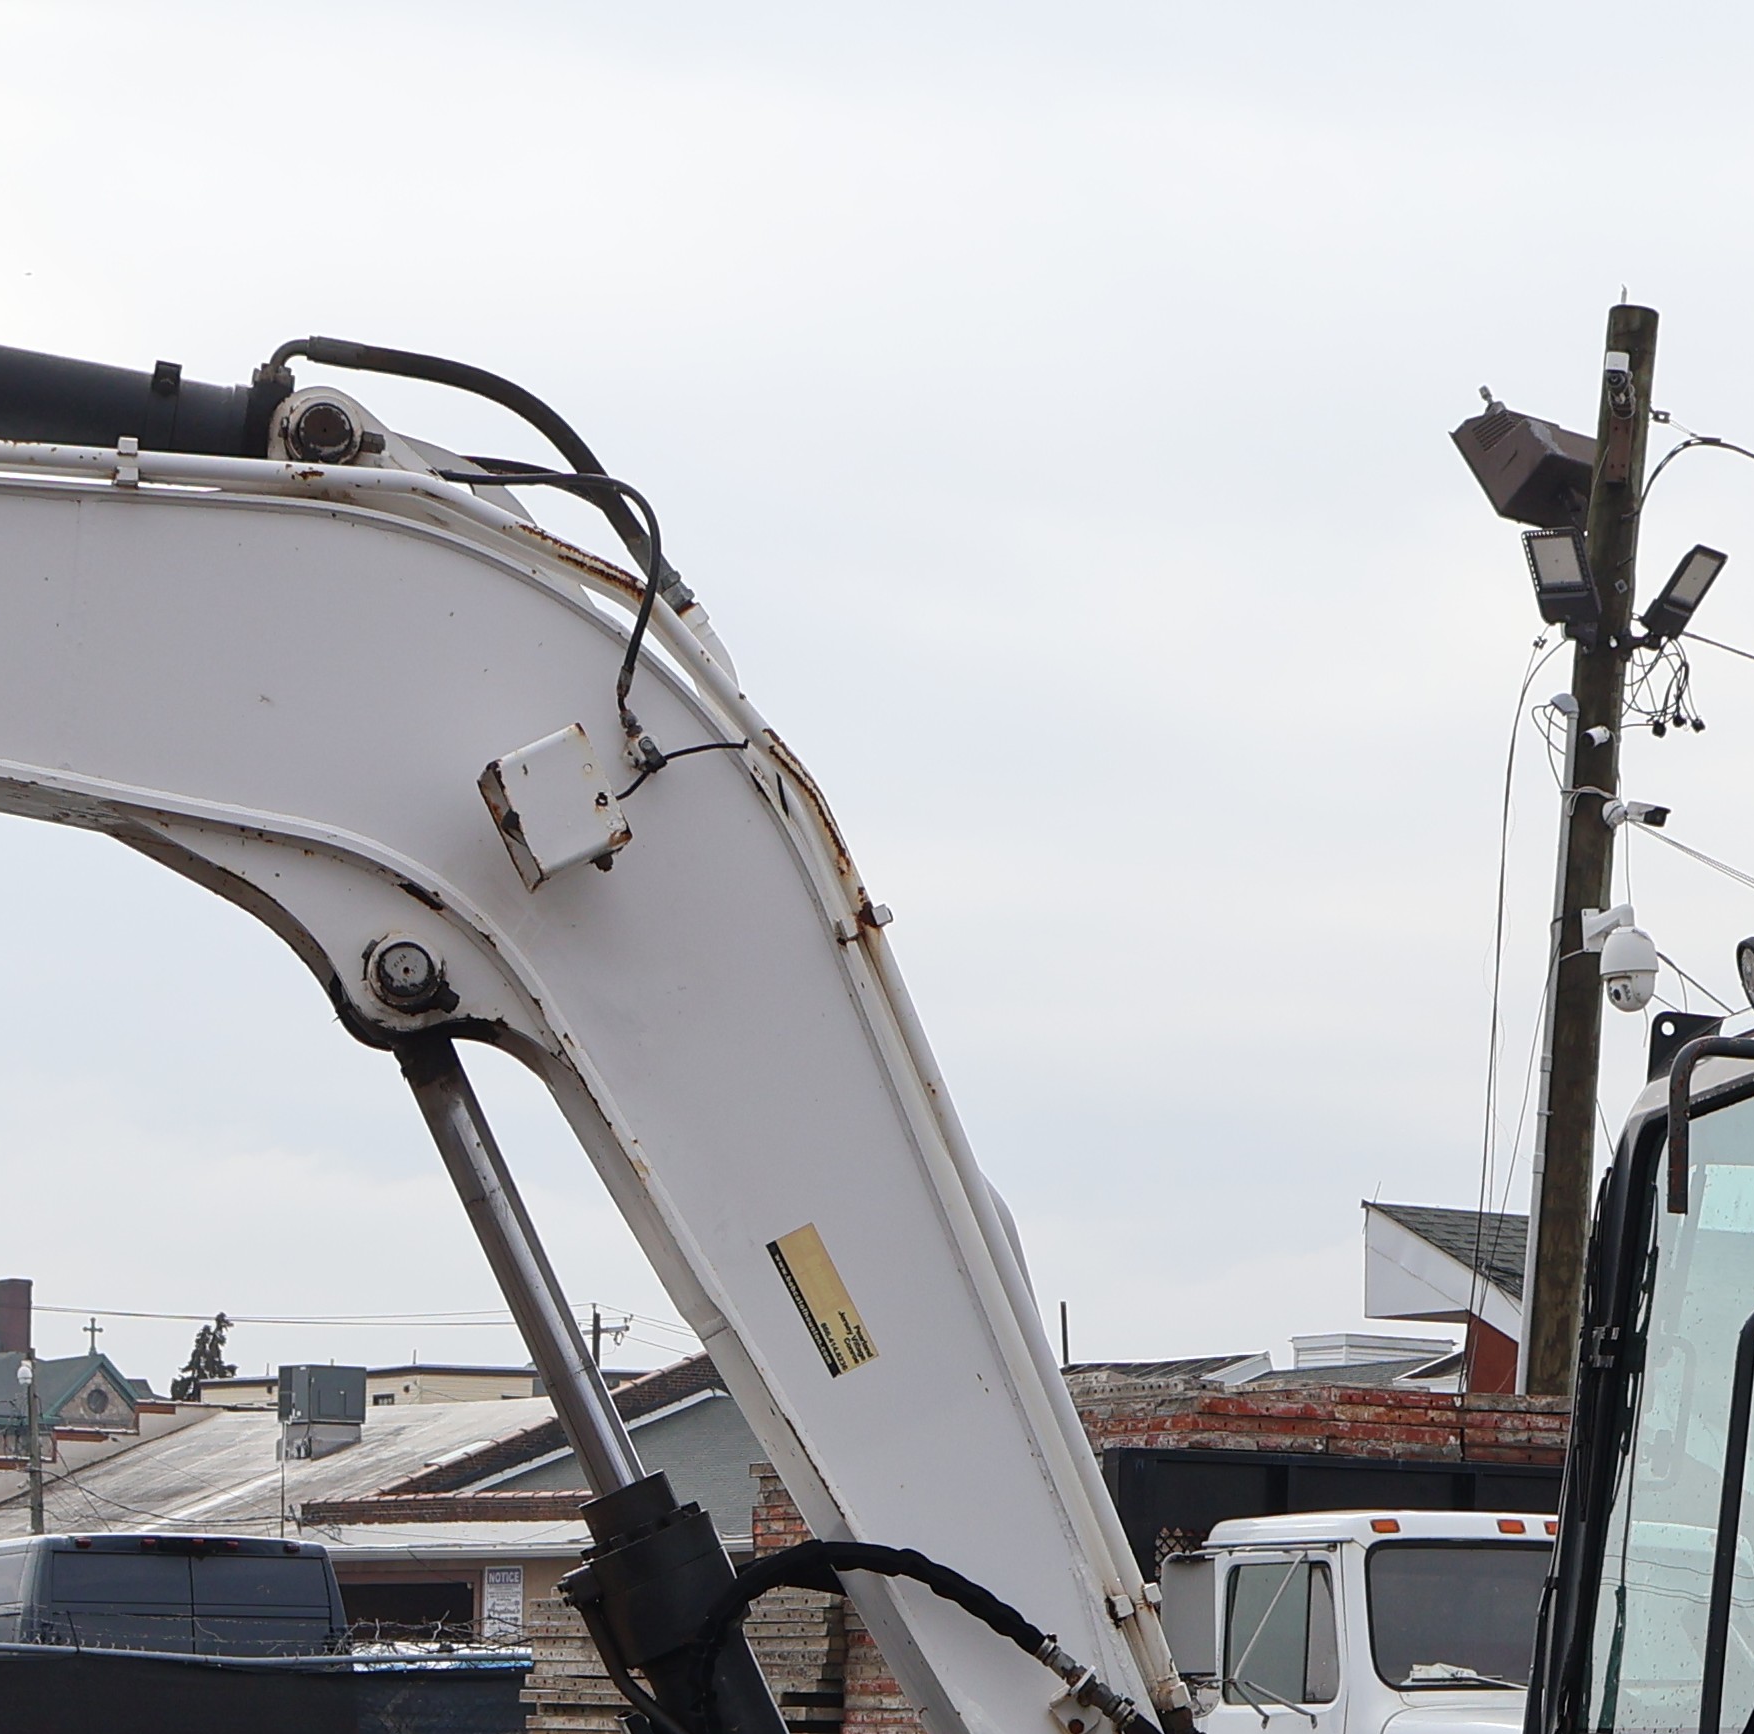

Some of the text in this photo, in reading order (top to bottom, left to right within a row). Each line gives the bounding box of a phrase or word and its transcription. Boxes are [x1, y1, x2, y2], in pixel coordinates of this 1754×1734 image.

[774, 1253, 833, 1366] www.bobcatofhouston.com
[837, 1310, 866, 1362] Jersey Village
[853, 1324, 875, 1358] Pearland
[488, 1571, 520, 1584] NOTICE
